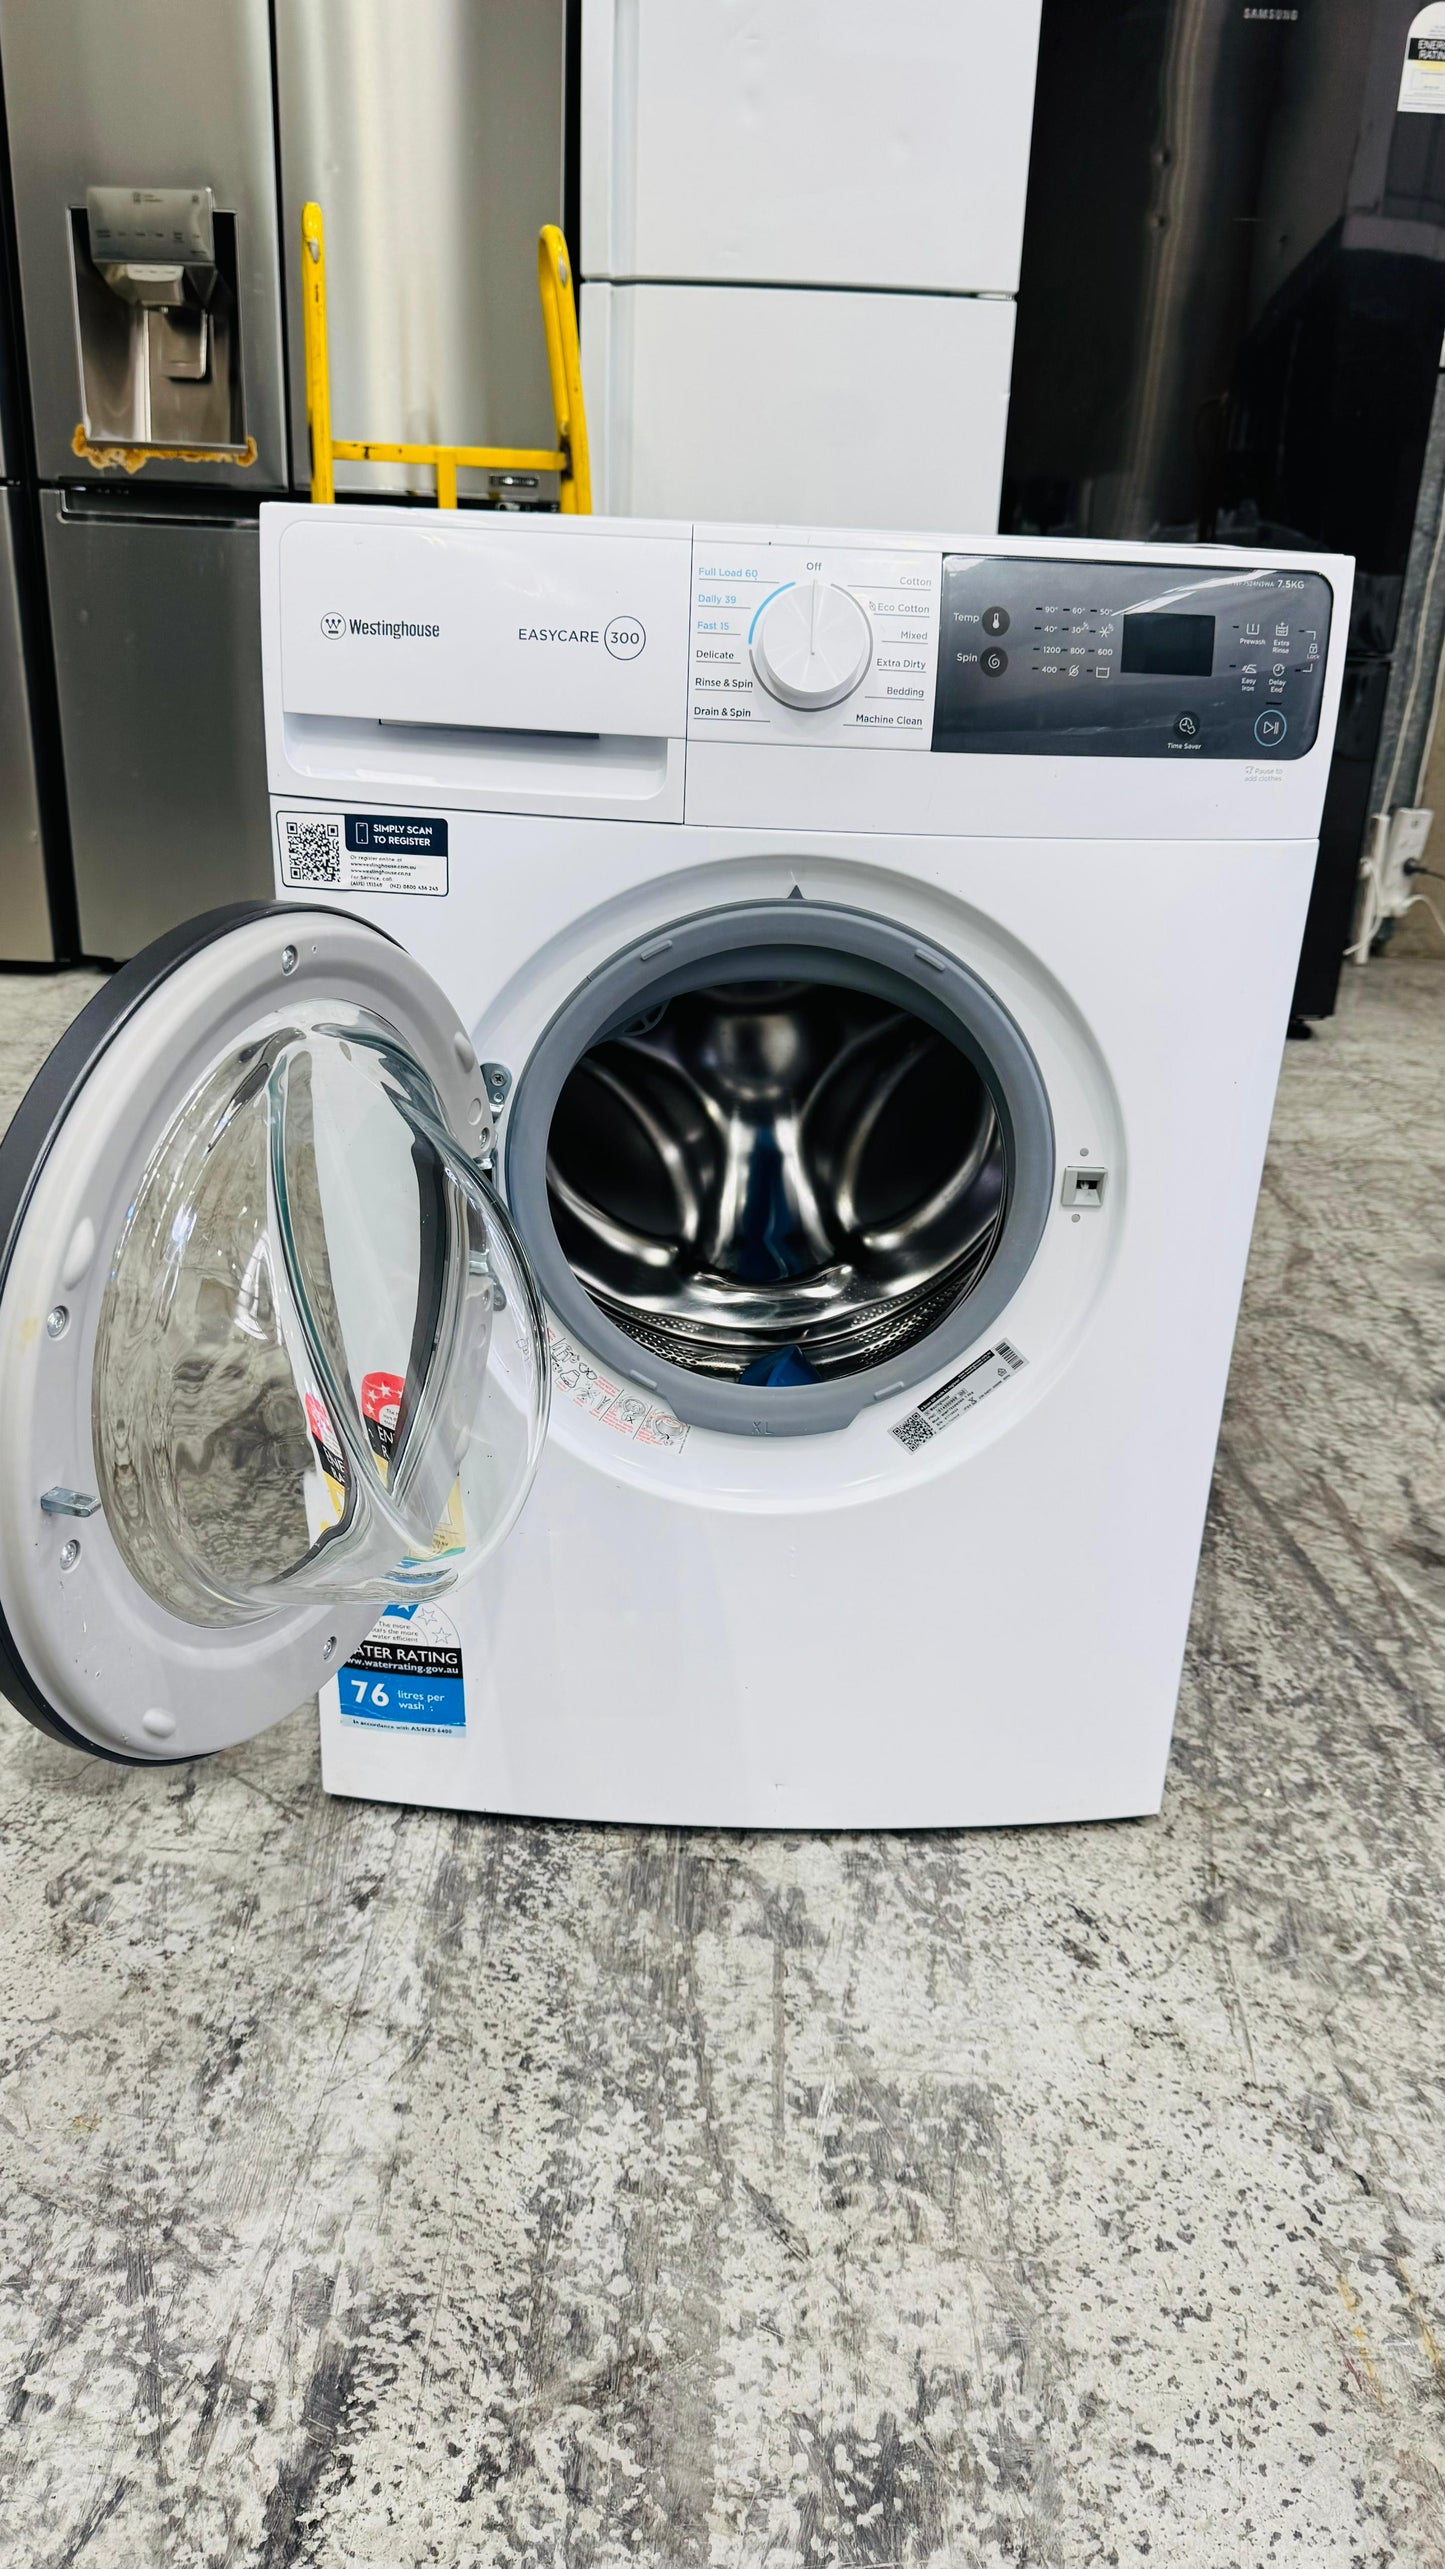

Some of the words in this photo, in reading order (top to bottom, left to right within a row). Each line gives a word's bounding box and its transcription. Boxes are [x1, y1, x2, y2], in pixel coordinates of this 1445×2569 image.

[1243, 8, 1298, 20] SAMSUNG
[806, 562, 822, 571] Off
[699, 568, 716, 576] Full
[719, 568, 742, 577] Load
[900, 577, 932, 586] Cotton
[1277, 580, 1304, 589] 7.5KG
[698, 594, 721, 605] Daily
[878, 603, 895, 611] Eco
[898, 604, 930, 613] Cotton
[954, 613, 980, 624] Temp
[349, 619, 440, 639] Westinghouse
[697, 621, 717, 630] Fast
[721, 622, 729, 630] 15
[519, 628, 599, 643] EASYCARE
[611, 632, 639, 644] 300
[901, 631, 928, 640] Mixed
[696, 650, 734, 659] Delicate
[957, 653, 978, 663] Spin
[877, 659, 900, 667] Extra
[904, 660, 926, 670] Dirty
[695, 678, 721, 686] Rinse
[724, 679, 729, 687] &
[732, 679, 753, 688] Spin
[887, 687, 924, 697] Bedding
[694, 707, 719, 716] Drain
[722, 708, 727, 716] &
[730, 708, 751, 718] Spin
[856, 714, 893, 723] Machine
[897, 716, 922, 725] Clean
[373, 824, 405, 834] SIMPLY
[407, 825, 433, 834] SCAN
[388, 836, 431, 846] REGISTER
[752, 1422, 773, 1434] XL
[354, 1645, 393, 1660] ATER
[396, 1649, 458, 1664] RATING
[351, 1680, 390, 1706] 76
[398, 1690, 424, 1700] litres
[427, 1694, 445, 1702] per
[398, 1702, 424, 1710] wash
